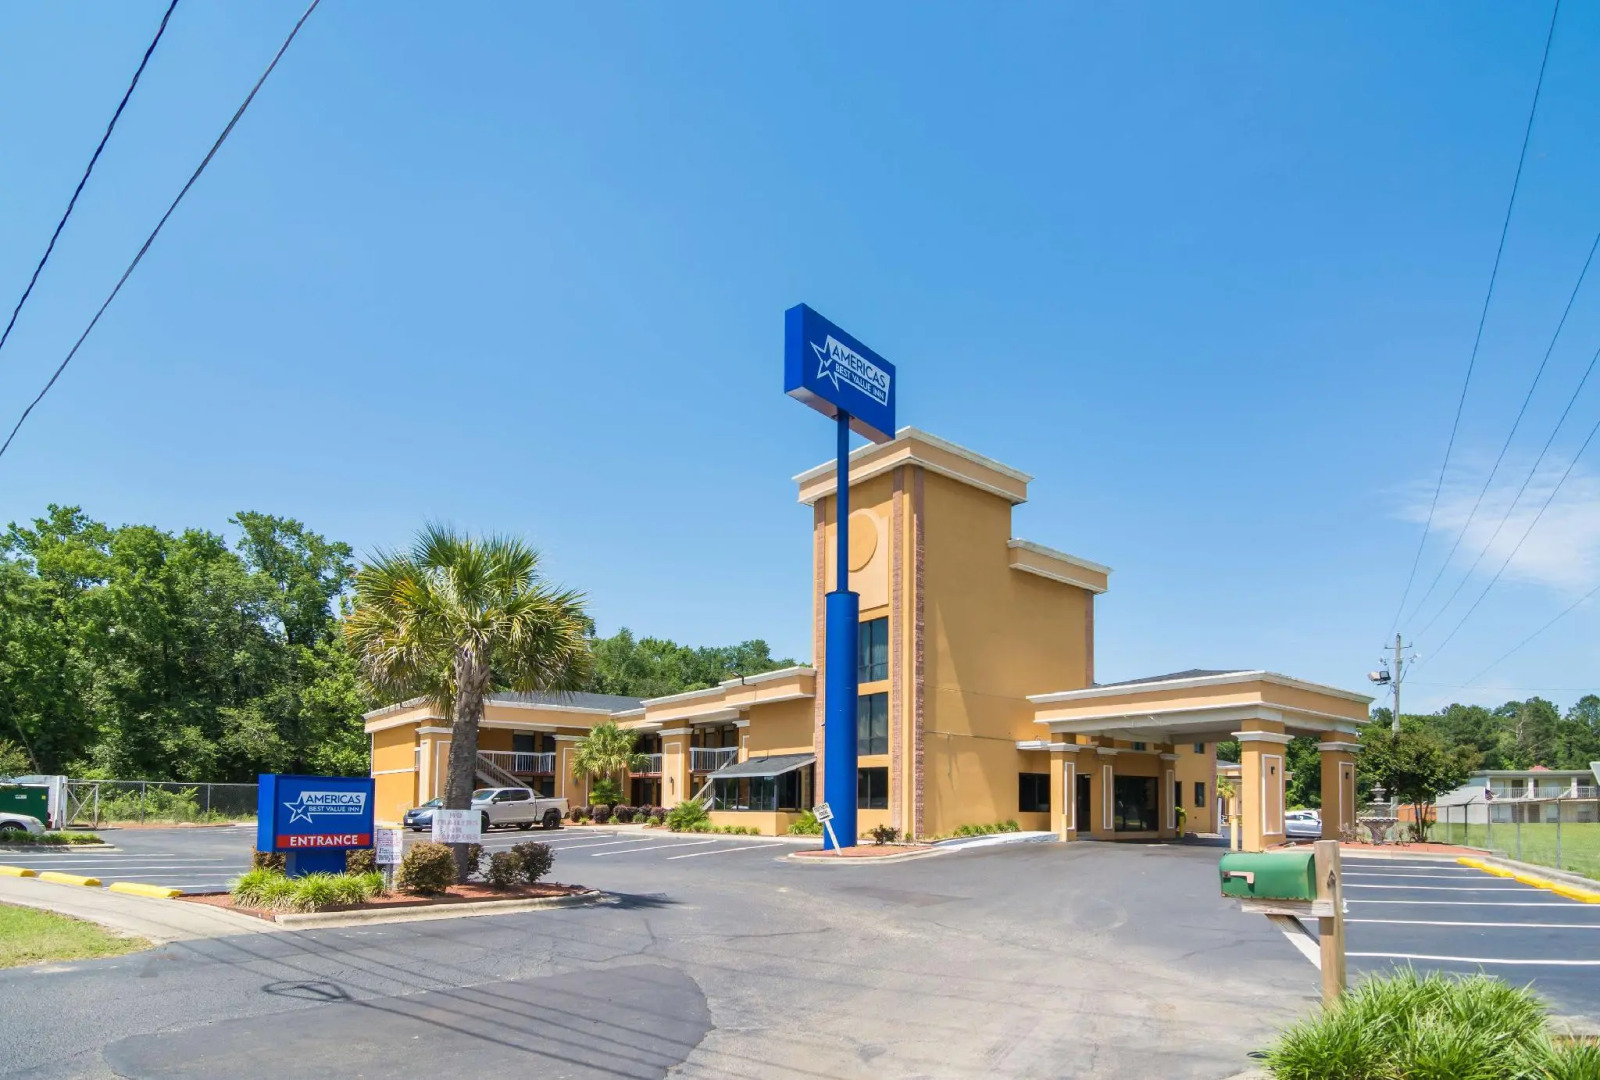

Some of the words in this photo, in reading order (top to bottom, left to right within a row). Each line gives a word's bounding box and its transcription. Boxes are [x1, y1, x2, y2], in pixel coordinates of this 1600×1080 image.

[832, 344, 886, 388] AMERICAS
[836, 362, 851, 378] BEST
[852, 373, 871, 391] VALUE
[873, 387, 884, 400] INN
[305, 794, 361, 805] AMERICAS
[289, 834, 359, 846] ENTRANCE
